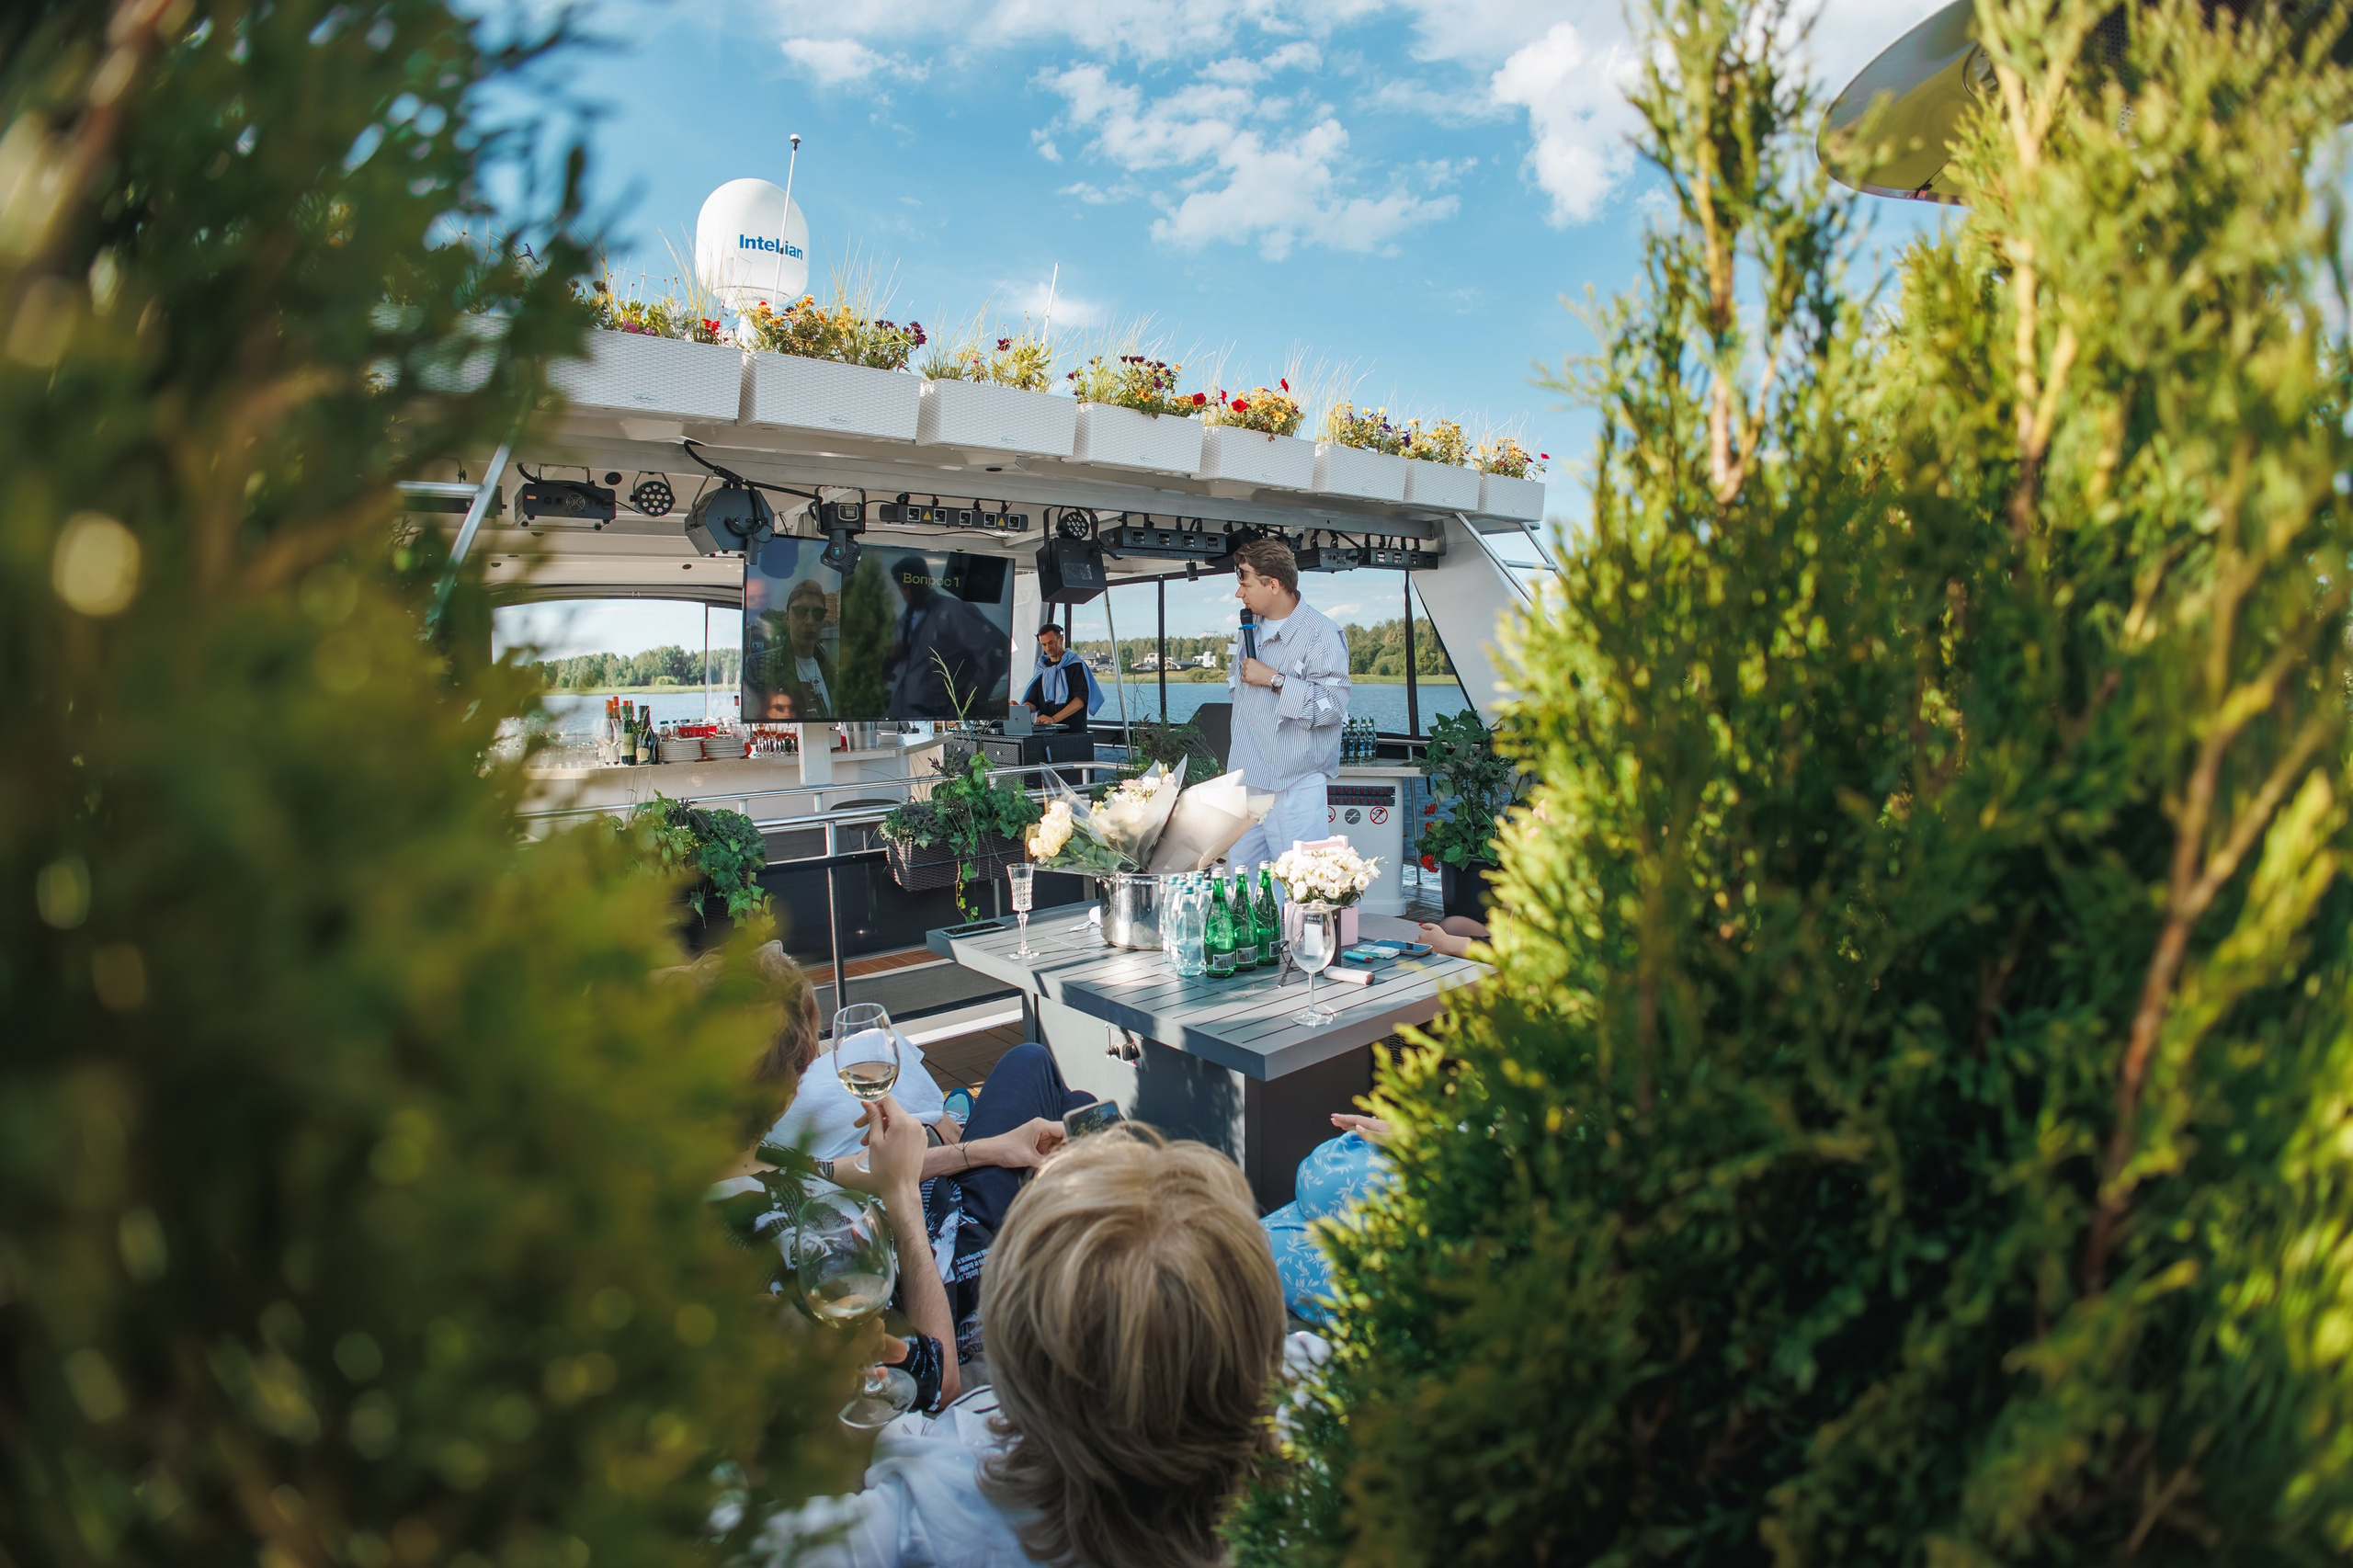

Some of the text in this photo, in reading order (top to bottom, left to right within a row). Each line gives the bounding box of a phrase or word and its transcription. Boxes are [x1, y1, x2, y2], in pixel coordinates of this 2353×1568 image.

[740, 234, 802, 260] Intelian
[903, 573, 960, 587] Вопрос 1
